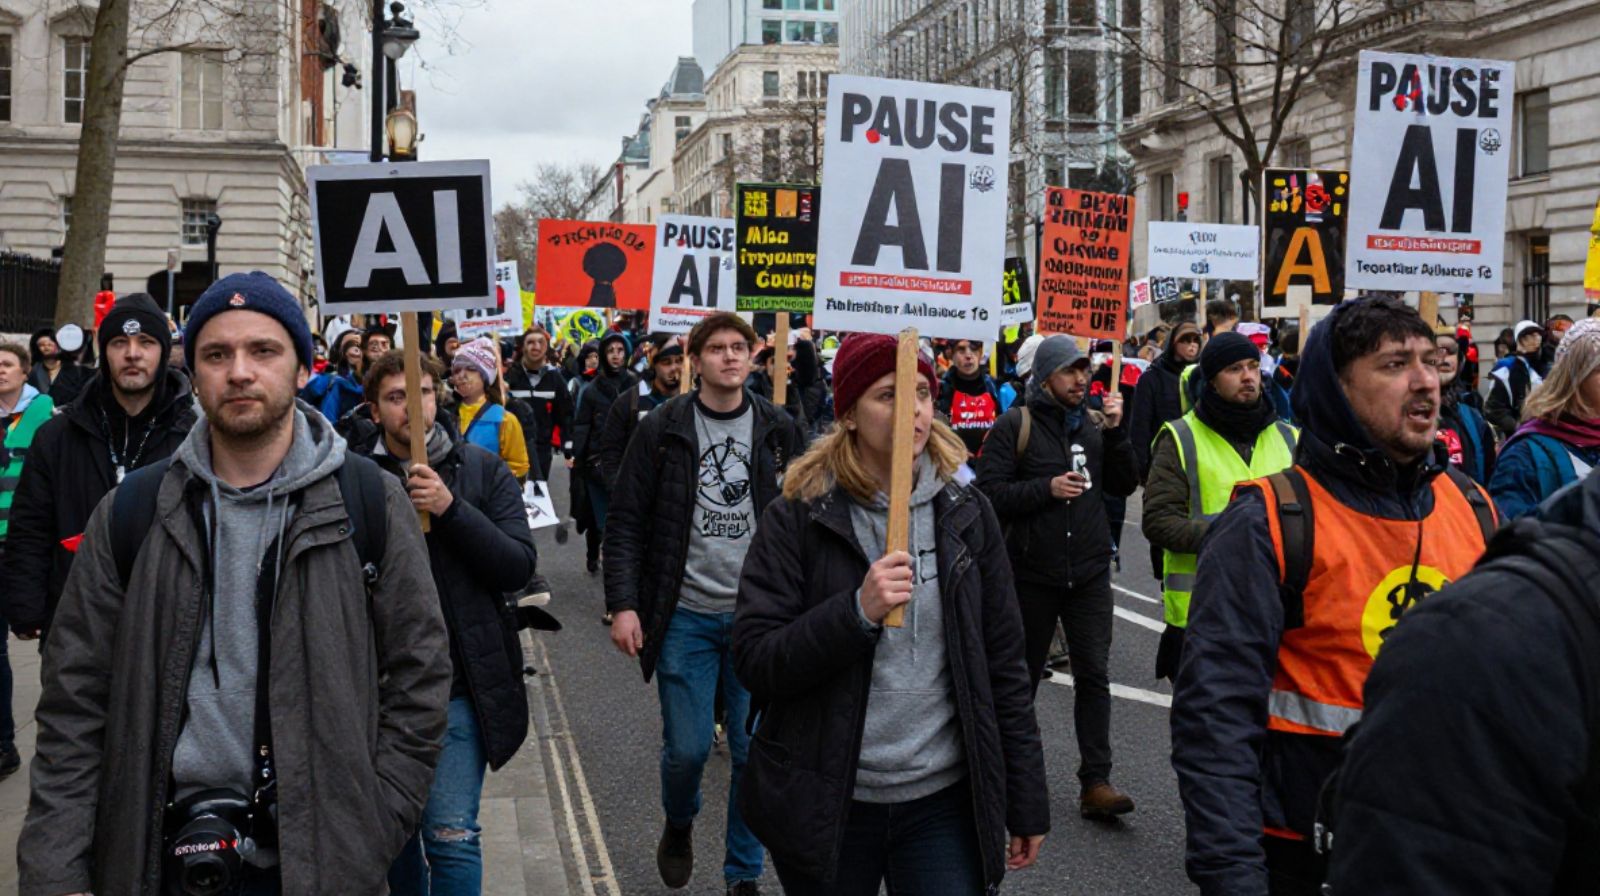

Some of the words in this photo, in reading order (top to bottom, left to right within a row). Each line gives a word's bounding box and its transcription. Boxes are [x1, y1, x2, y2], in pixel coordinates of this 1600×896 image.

[1369, 61, 1500, 118] PAUSE
[840, 92, 995, 155] PAUSE
[1379, 124, 1478, 233] AI
[344, 189, 463, 288] AI
[664, 222, 735, 252] PAUSE
[851, 157, 966, 273] AI
[668, 254, 720, 307] AI
